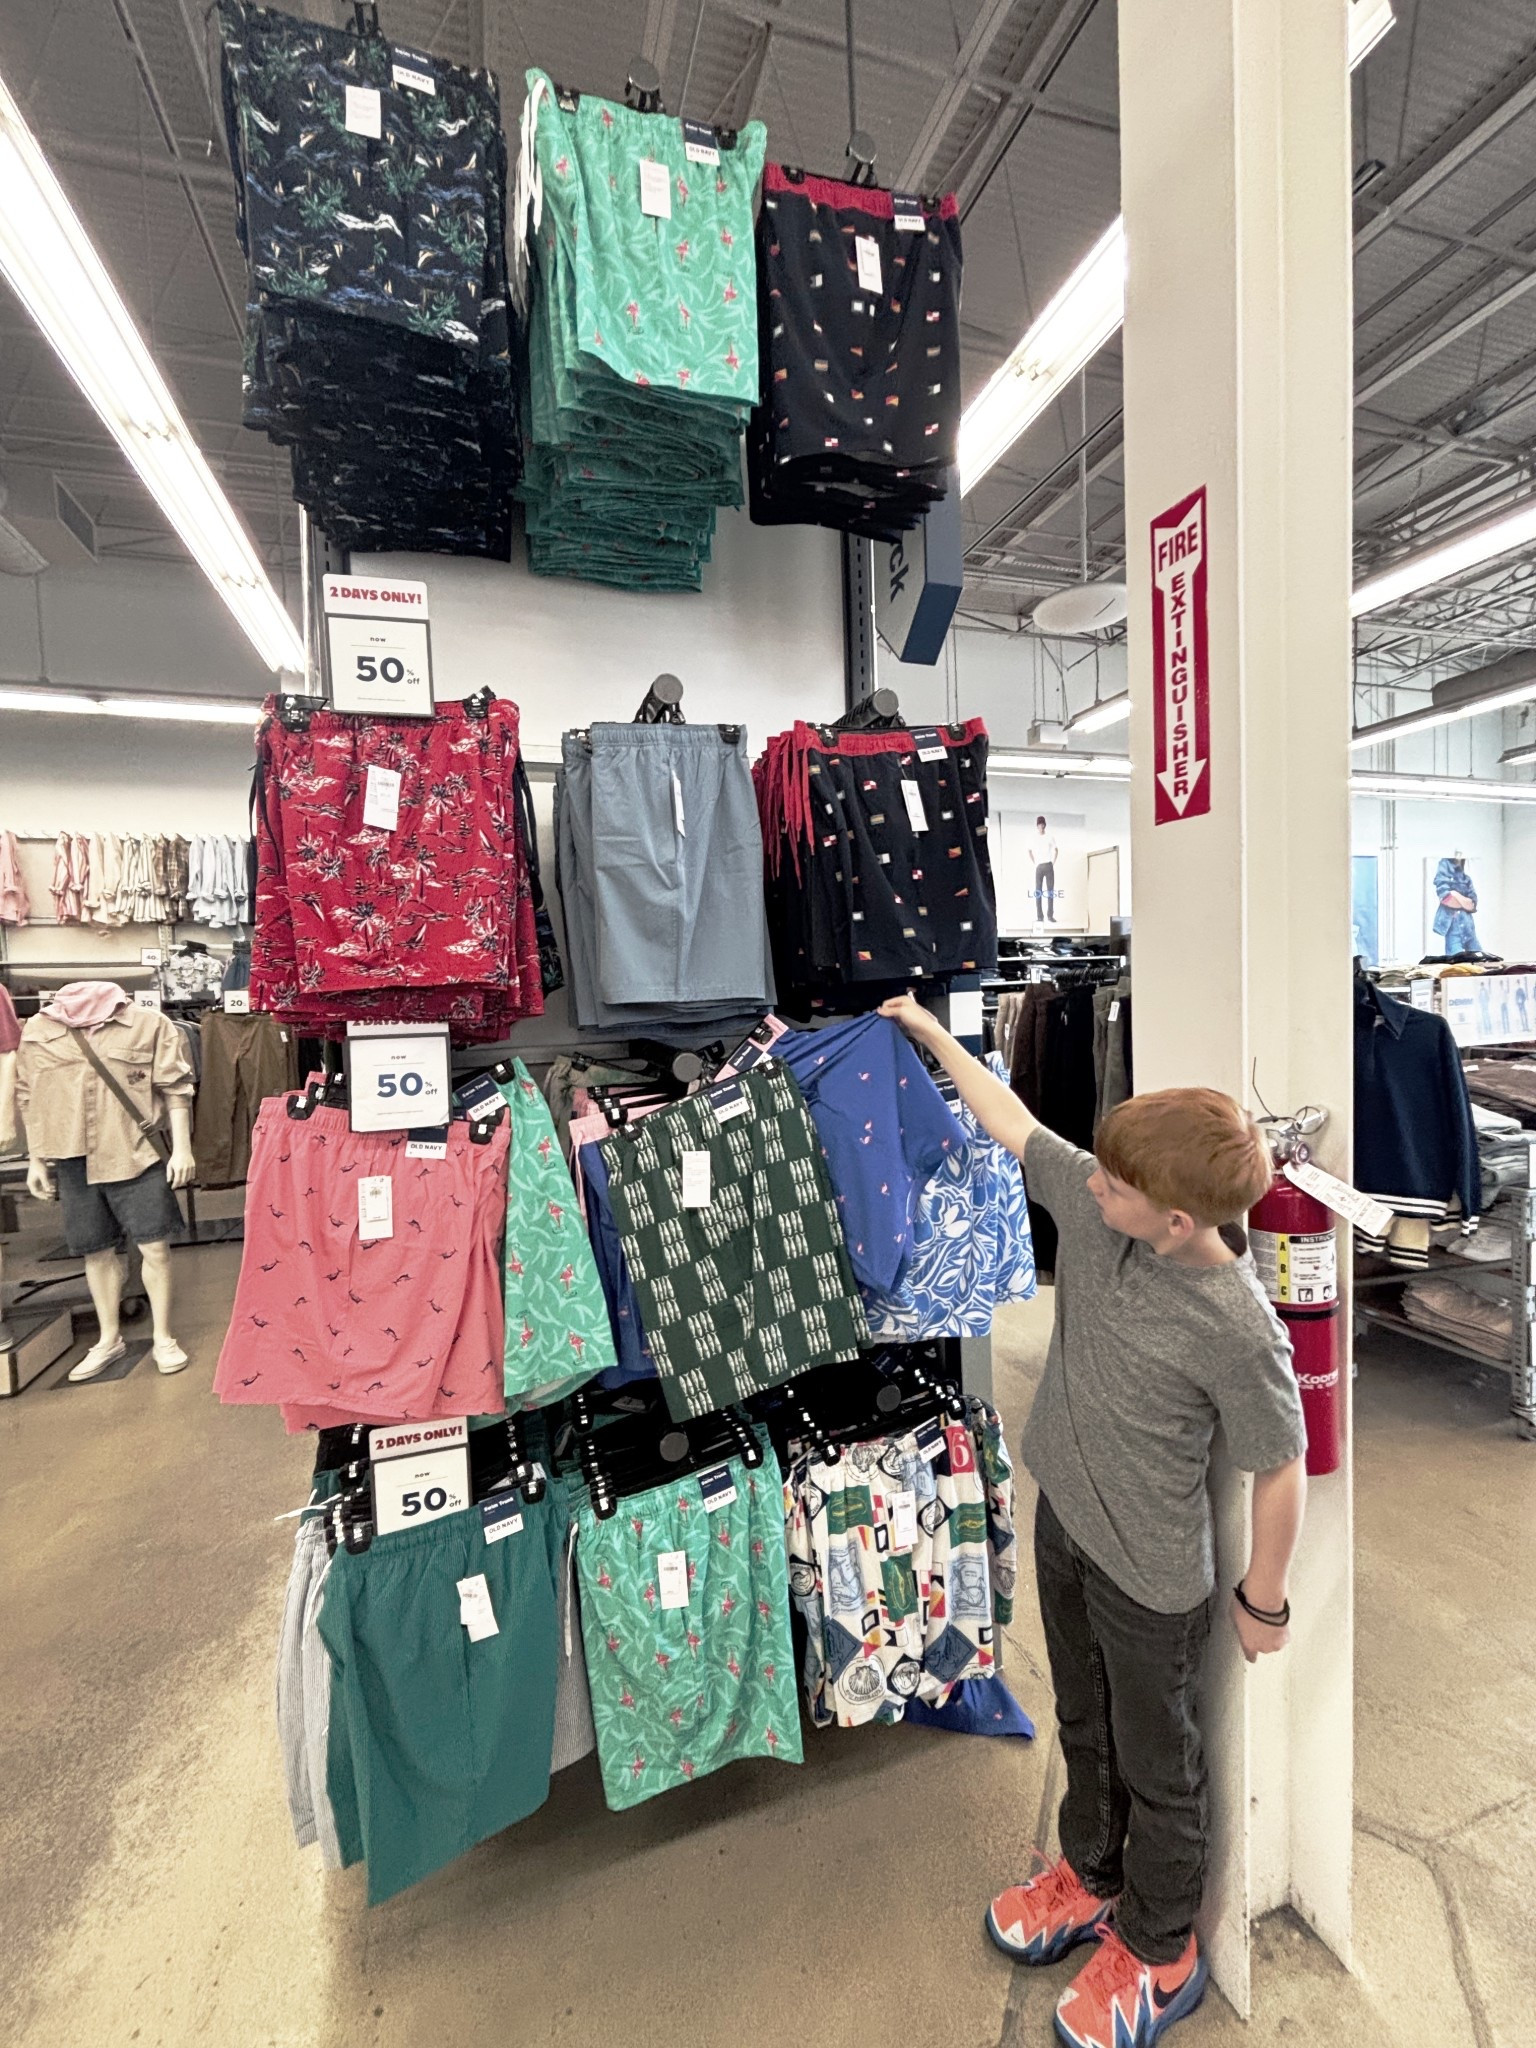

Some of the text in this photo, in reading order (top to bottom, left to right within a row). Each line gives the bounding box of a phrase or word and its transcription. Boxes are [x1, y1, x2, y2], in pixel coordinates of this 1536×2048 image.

[1158, 521, 1198, 573] FIRE
[329, 586, 422, 605] 2 DAYS ONLY!
[356, 655, 405, 684] 50
[406, 677, 420, 685] off
[1170, 570, 1189, 798] EXTINGUISHER
[1027, 889, 1065, 899] LOOSE
[230, 999, 243, 1007] 20
[376, 1072, 424, 1098] 50
[425, 1088, 438, 1096] off
[473, 1096, 500, 1114] OLD NAVY
[718, 1101, 744, 1115] OLD NAVY
[424, 1143, 442, 1151] NAVY
[1279, 1241, 1286, 1252] A
[1280, 1263, 1287, 1274] B
[1281, 1285, 1287, 1296] C
[375, 1425, 463, 1450] 2 DAYS ONLY!
[953, 1432, 970, 1468] 6
[414, 1471, 430, 1479] now
[401, 1487, 447, 1517] 50
[449, 1500, 462, 1508] off
[706, 1490, 732, 1505] OLD NAVY
[484, 1502, 499, 1512] Swim
[488, 1517, 518, 1534] OLD NAVY
